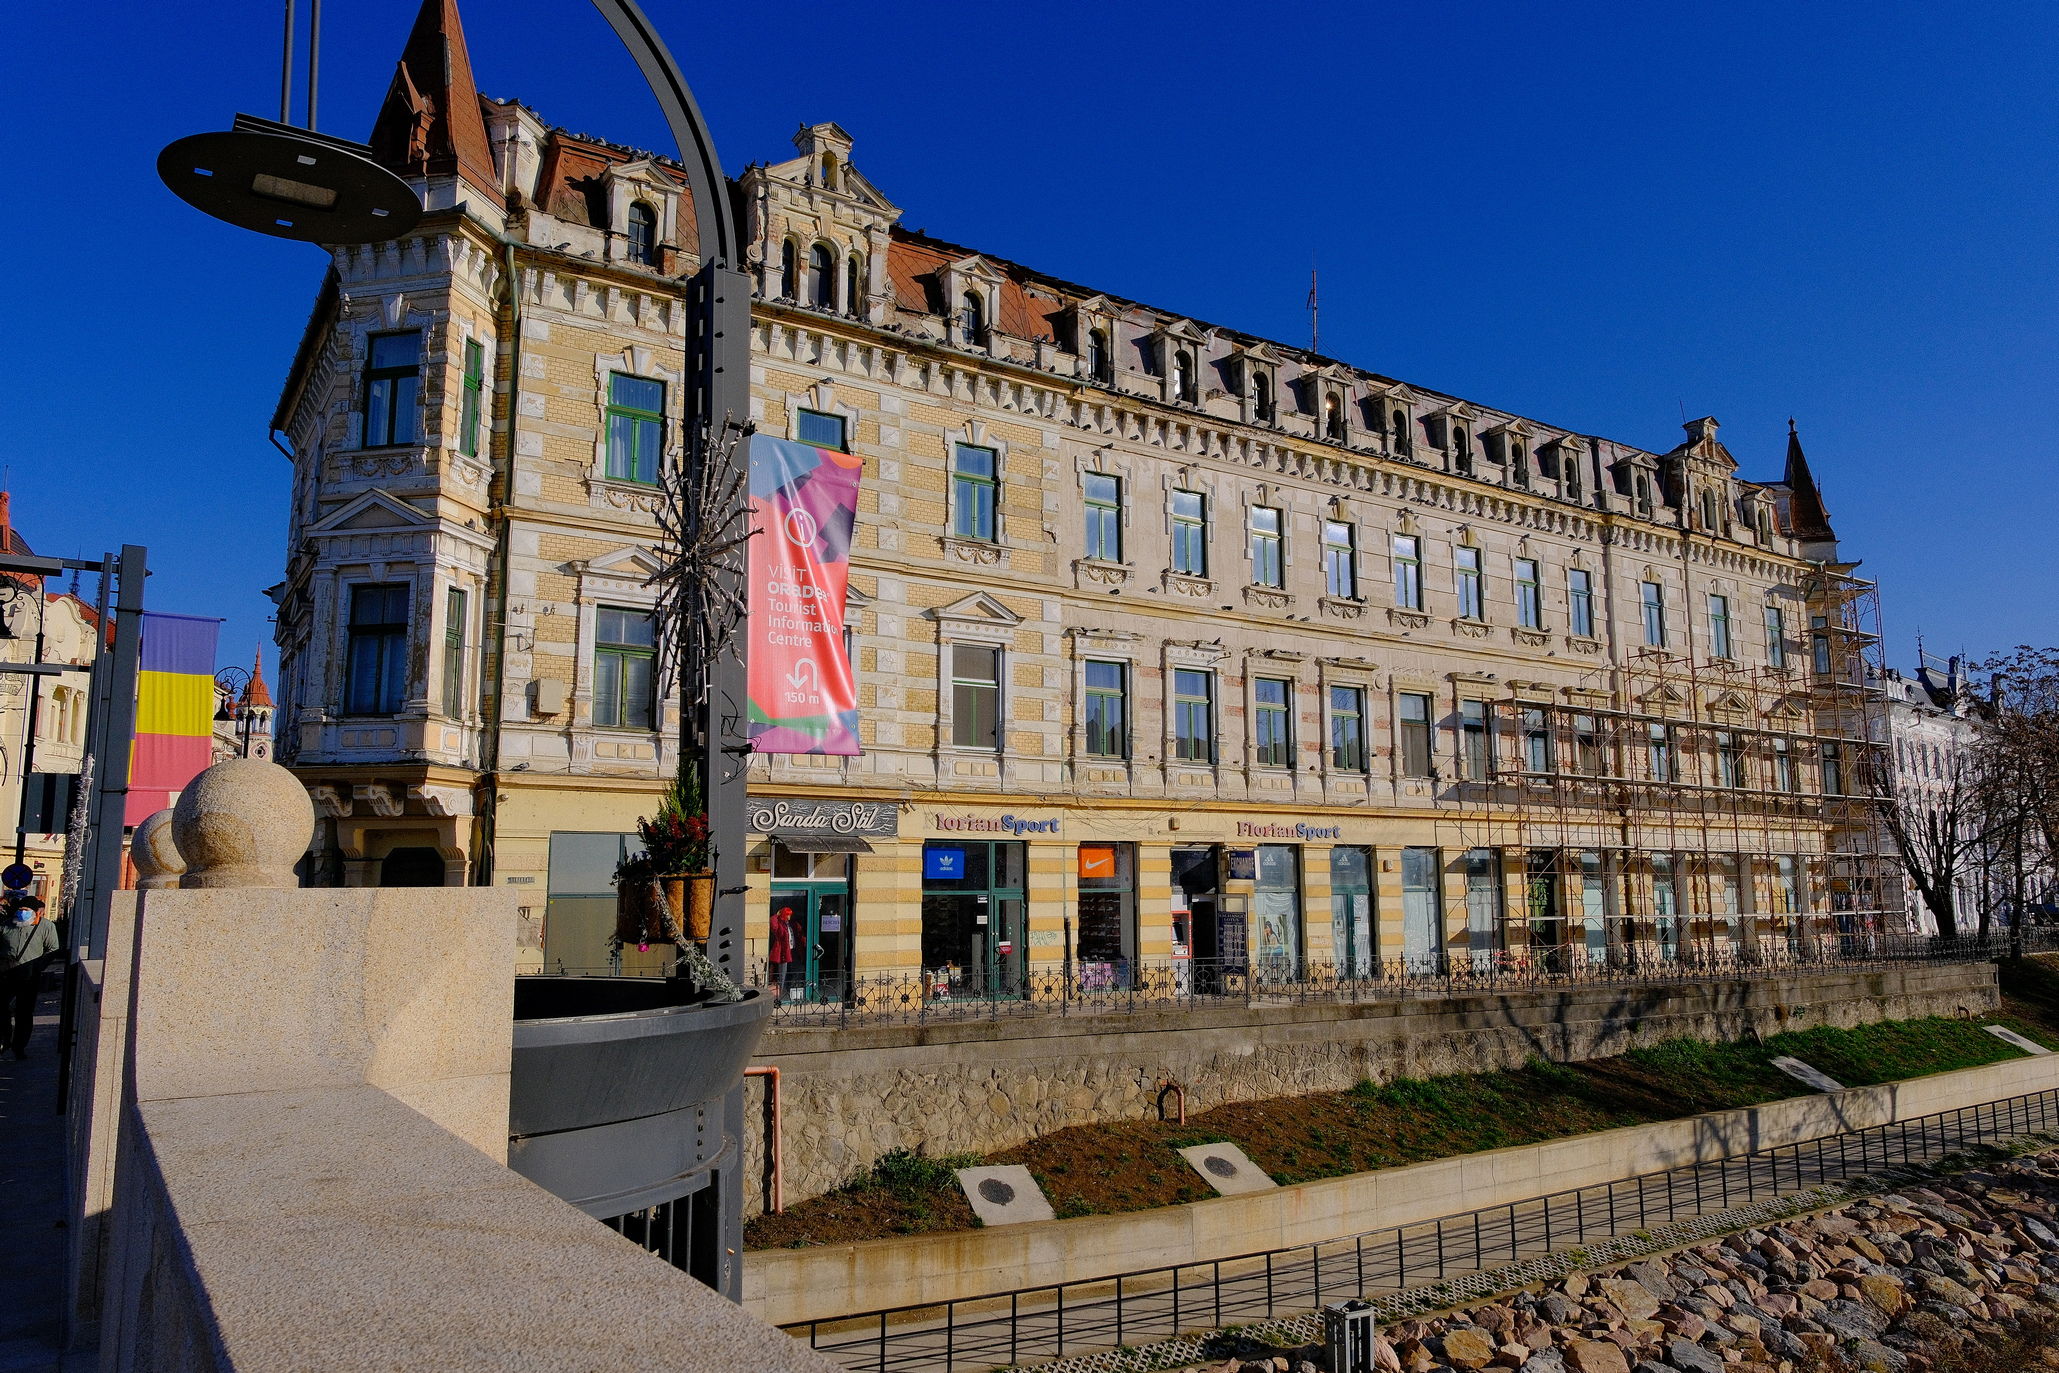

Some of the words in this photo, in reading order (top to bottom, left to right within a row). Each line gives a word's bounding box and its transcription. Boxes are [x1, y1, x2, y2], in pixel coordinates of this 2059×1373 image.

[768, 598, 816, 616] Tourist
[768, 614, 840, 636] Informatio
[768, 632, 812, 648] Centre
[784, 692, 806, 704] 150
[808, 695, 820, 705] m
[831, 802, 883, 833] Stil
[1237, 821, 1341, 841] FlorianSport
